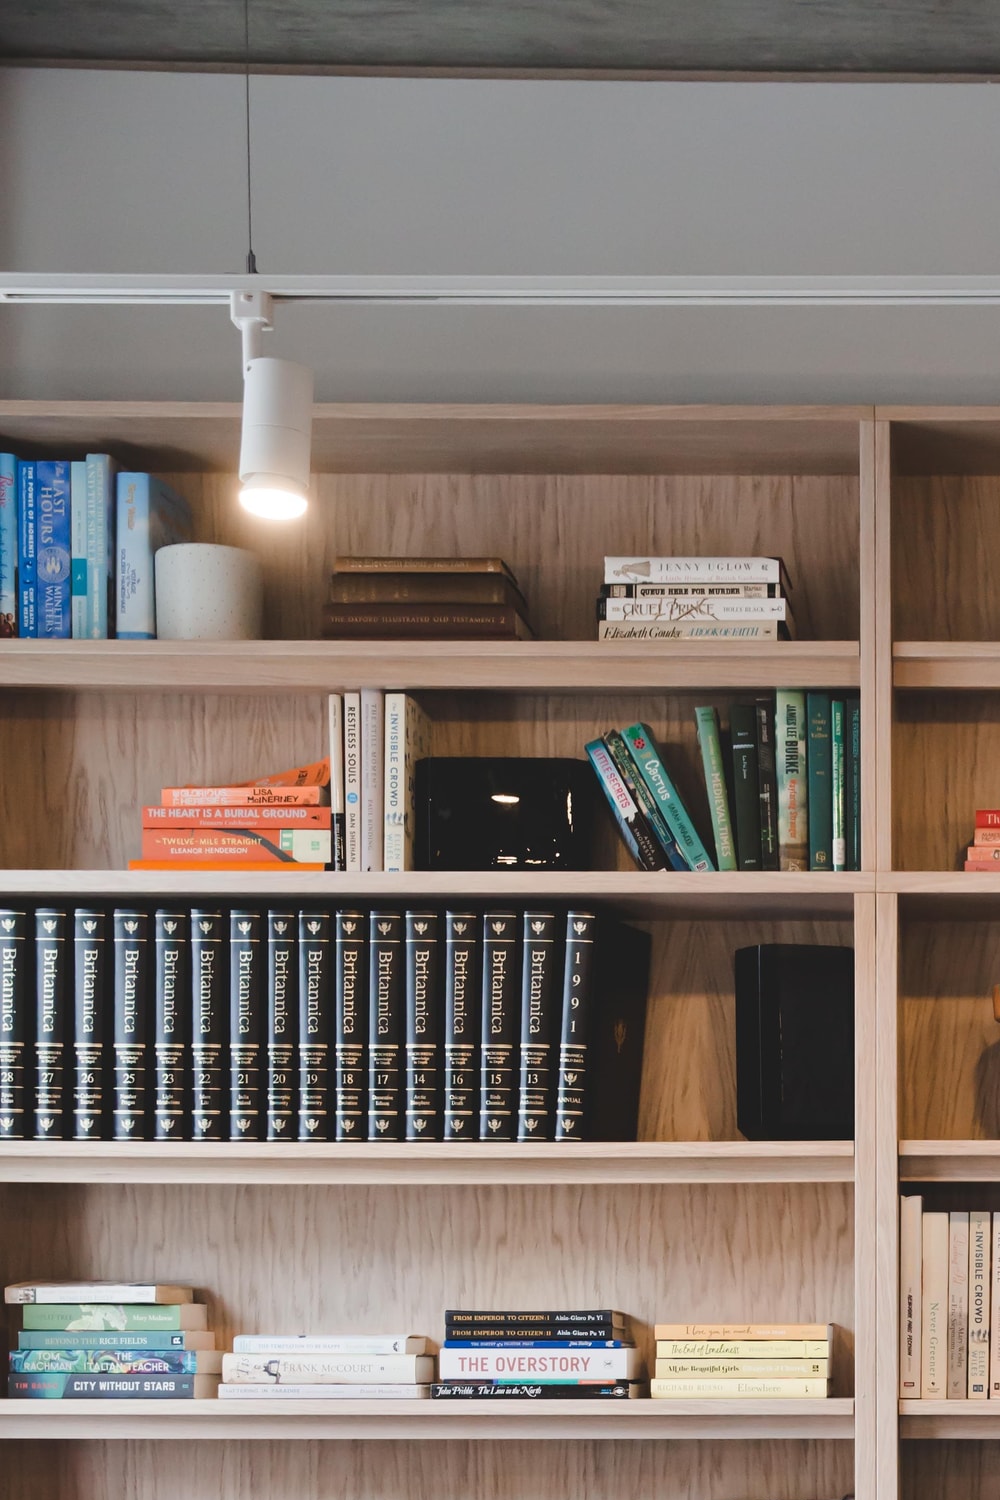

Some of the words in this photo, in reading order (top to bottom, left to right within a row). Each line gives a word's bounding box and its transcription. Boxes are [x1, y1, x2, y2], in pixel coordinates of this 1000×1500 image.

[41, 487, 52, 544] HOURS
[658, 563, 699, 572] JENNY
[708, 563, 753, 571] UGLOW
[45, 586, 53, 632] WALTERS
[348, 707, 356, 748] RESTLESS
[390, 713, 398, 762] INVISIBLE
[348, 754, 356, 784] SOULS
[390, 767, 398, 807] CROWD
[148, 809, 165, 817] THE
[169, 809, 198, 817] HEART
[203, 809, 212, 817] IS
[215, 809, 222, 817] A
[225, 809, 259, 818] BURIAL
[263, 809, 307, 818] GROUND
[711, 772, 725, 824] MEDIEVAL
[719, 826, 730, 857] TIMES
[2, 947, 17, 1031] Britannica
[42, 949, 58, 1032] Britannica
[83, 949, 98, 1033] Britannica
[124, 949, 138, 1033] Britannica
[164, 950, 179, 1033] Britannica
[199, 950, 214, 1034] Britannica
[238, 950, 253, 1034] Britannica
[274, 950, 289, 1034] Britannica
[308, 950, 322, 1034] Britannica
[343, 950, 357, 1034] Britannica
[378, 950, 393, 1035] Britannica
[415, 950, 430, 1034] Britannica
[453, 950, 468, 1035] Britannica
[491, 950, 507, 1034] Britannica
[530, 950, 546, 1034] Britannica
[974, 1231, 984, 1280] INVISIBLE
[929, 1302, 939, 1333] Never
[974, 1284, 983, 1324] CROWD
[24, 1362, 72, 1370] RACHMAN
[38, 1352, 60, 1361] TOM
[114, 1352, 132, 1360] THE
[458, 1357, 488, 1372] THE
[496, 1357, 591, 1372] OVERSTORY
[929, 1337, 939, 1377] Greener
[74, 1381, 95, 1391] CITY
[100, 1381, 140, 1391] WITHOUT
[144, 1381, 175, 1391] STARS
[737, 1383, 781, 1392] Elsewhere
